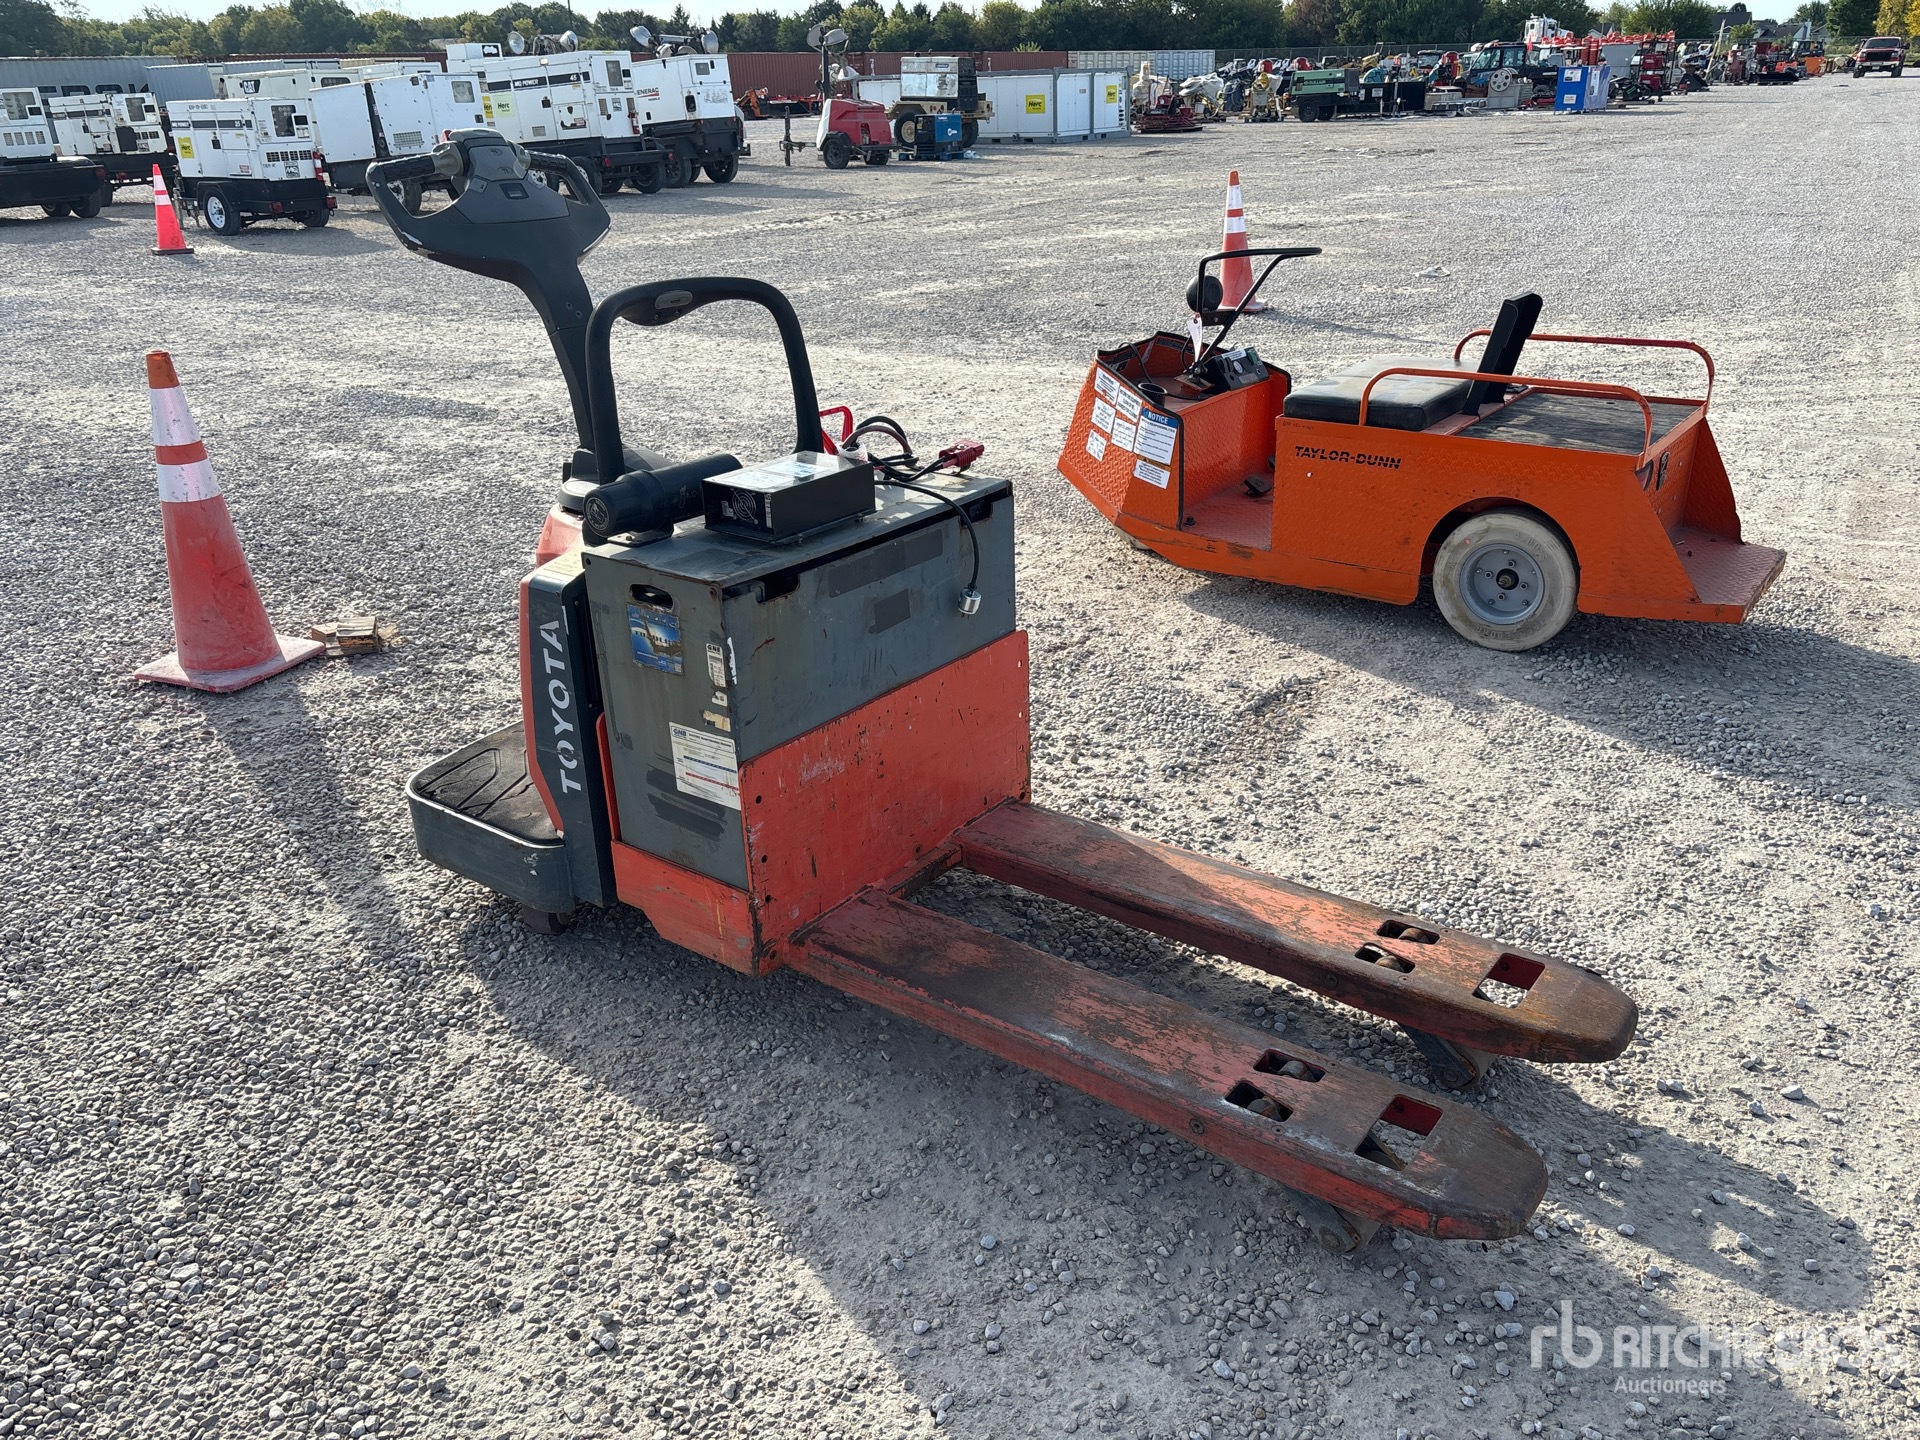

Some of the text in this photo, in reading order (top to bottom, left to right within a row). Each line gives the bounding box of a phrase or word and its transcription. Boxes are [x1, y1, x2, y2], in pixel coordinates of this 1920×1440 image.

[243, 81, 255, 93] CAT
[522, 78, 539, 87] POWER
[634, 87, 660, 95] ENERAC
[497, 102, 510, 110] Herc
[1147, 411, 1169, 425] NOTICE
[1295, 446, 1402, 469] TAYLOR-DUNN
[707, 644, 721, 653] GNB
[539, 620, 582, 794] TOYOTA
[672, 728, 687, 737] GNB
